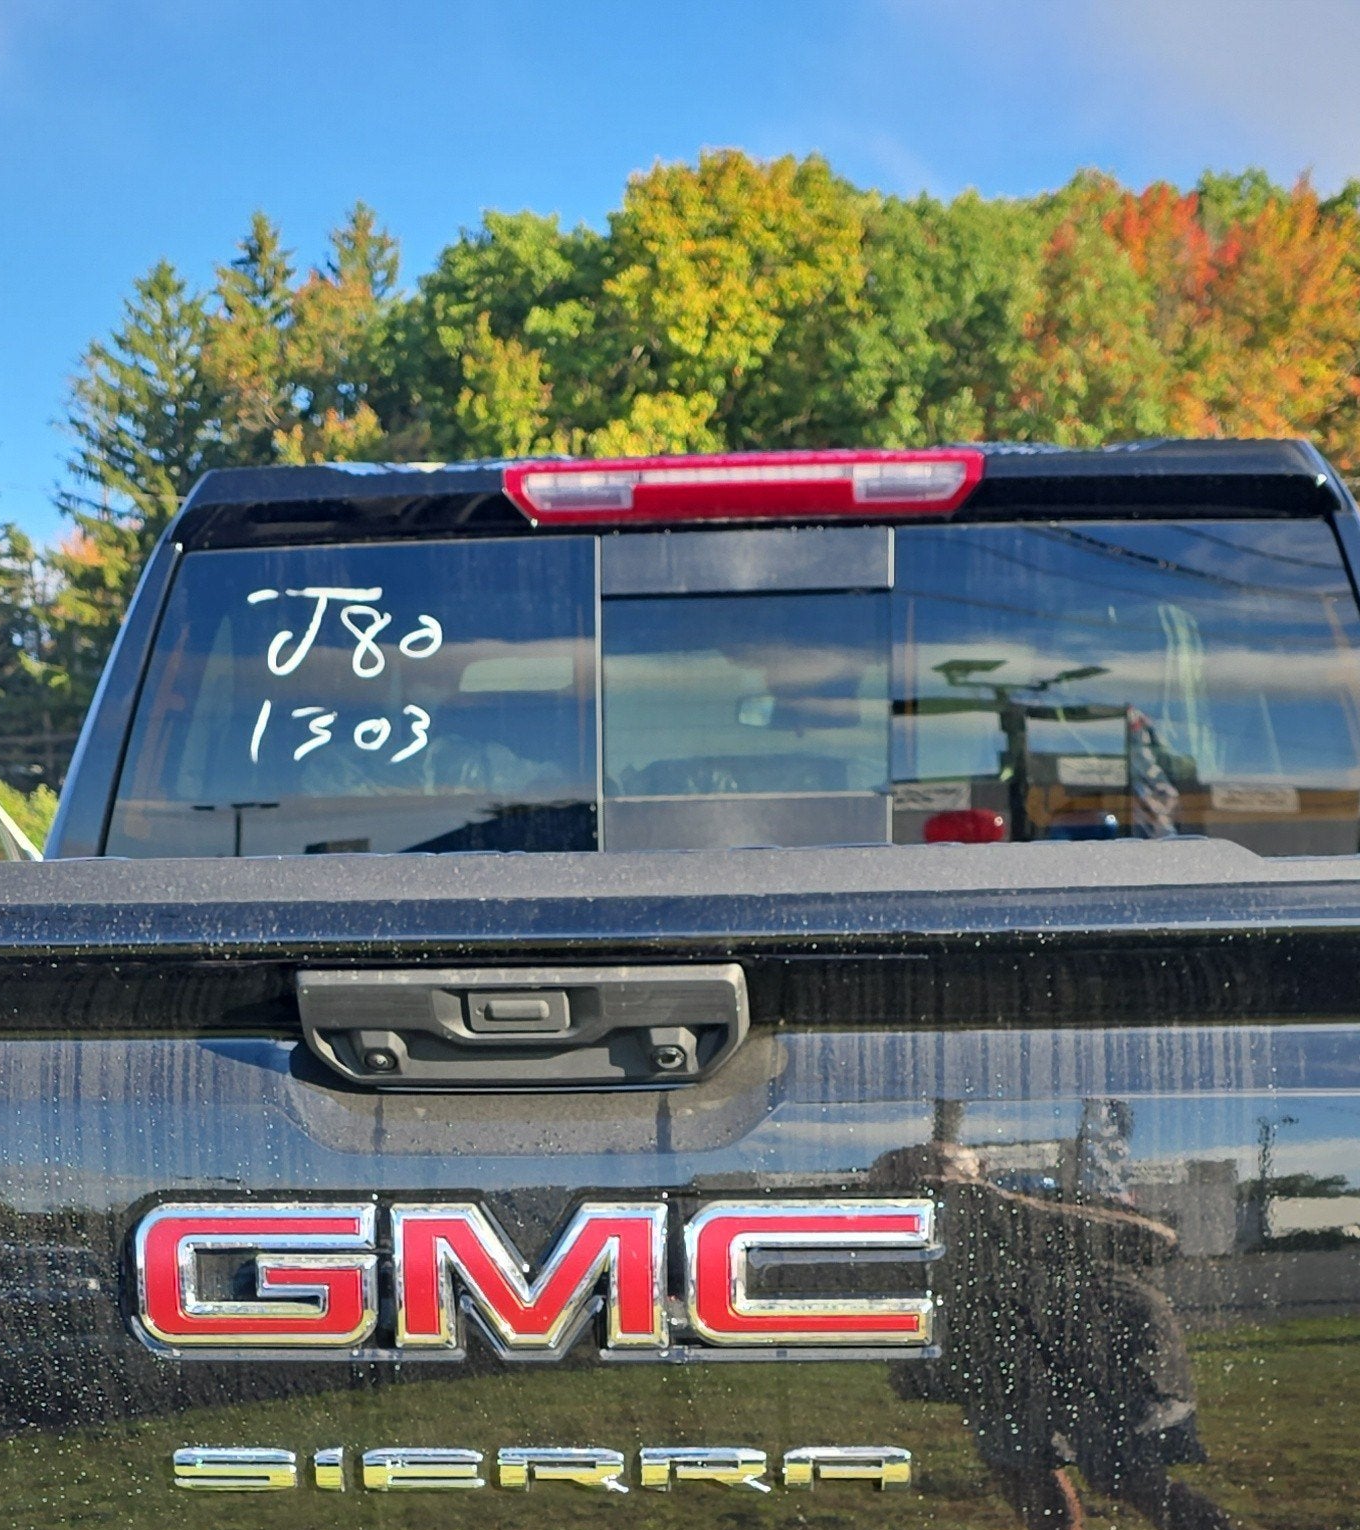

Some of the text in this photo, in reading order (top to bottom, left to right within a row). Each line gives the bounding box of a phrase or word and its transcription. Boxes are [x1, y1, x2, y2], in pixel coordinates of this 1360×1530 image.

[250, 699, 430, 764] 1303
[134, 1200, 943, 1360] GMC
[173, 1446, 914, 1493] SIERRA
